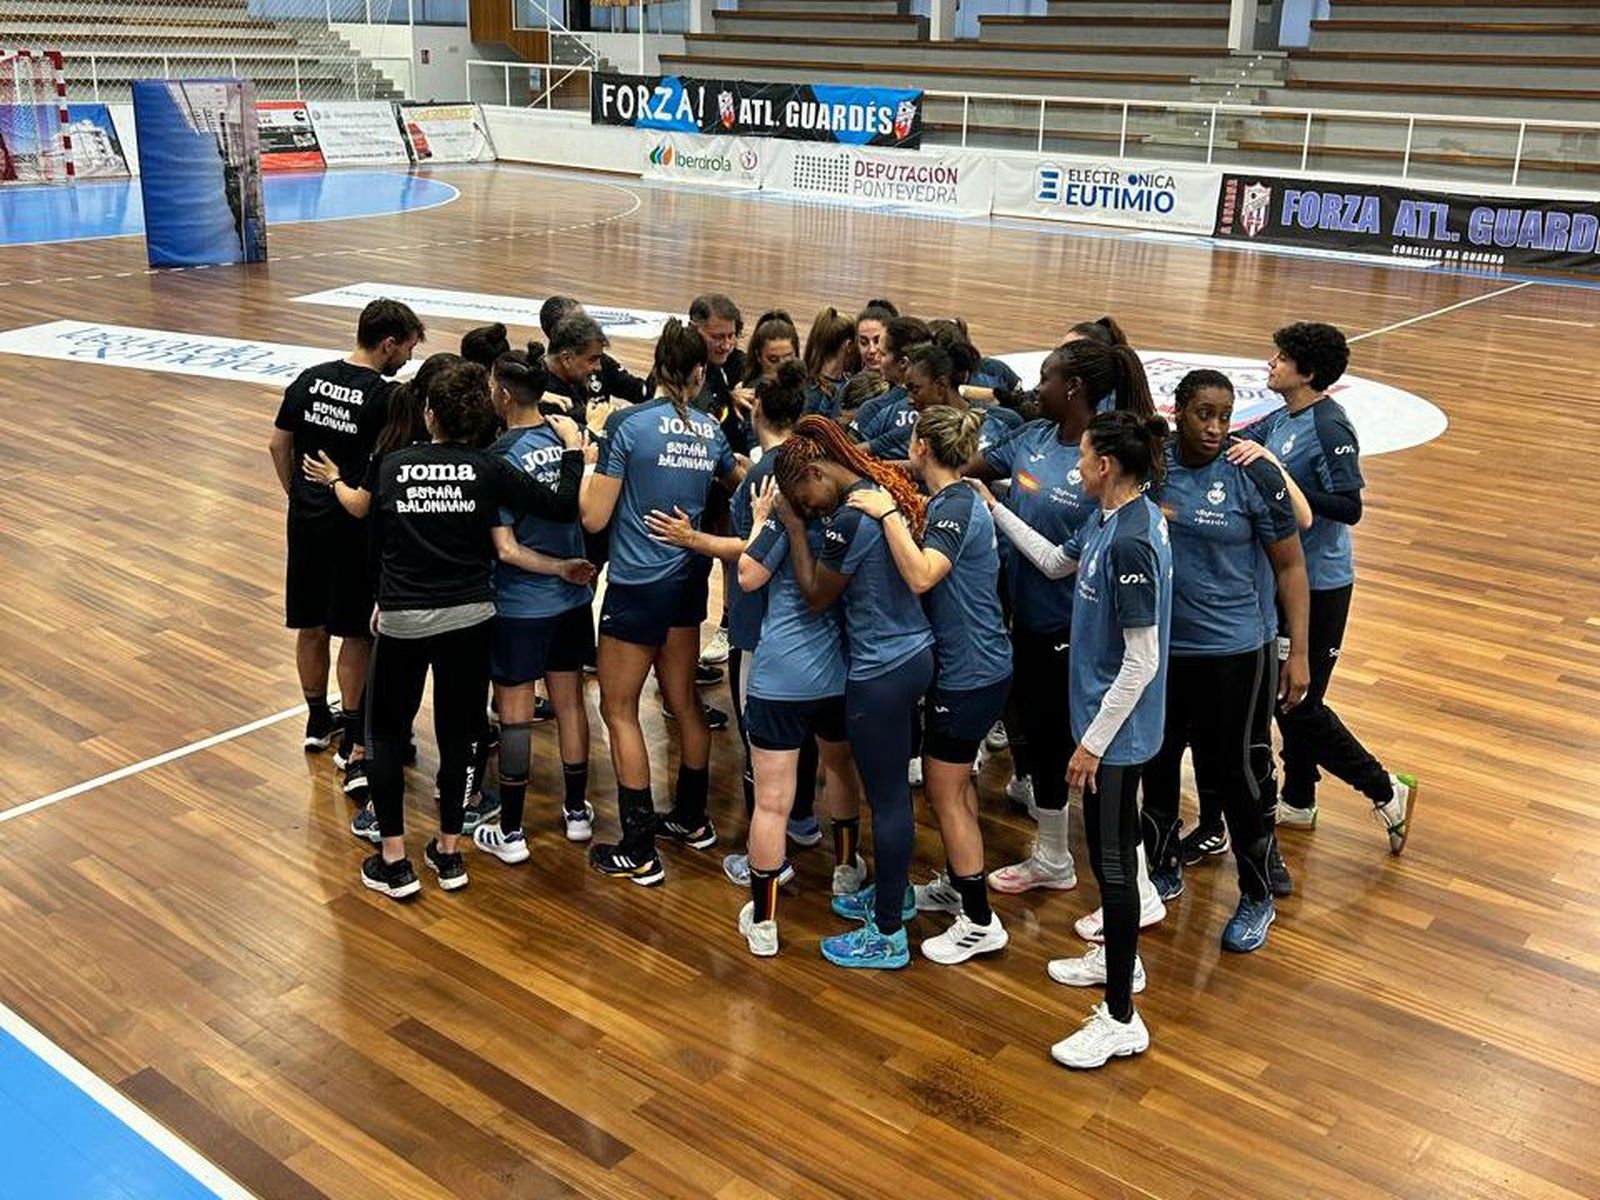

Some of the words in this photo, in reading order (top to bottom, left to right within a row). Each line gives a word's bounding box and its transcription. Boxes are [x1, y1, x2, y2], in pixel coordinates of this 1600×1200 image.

[602, 83, 705, 127] FORZA!
[739, 101, 780, 127] ATL.
[785, 100, 893, 135] GUARDÉS
[675, 151, 731, 172] Iberdrola
[854, 160, 958, 184] DEPUTACIÓN
[853, 180, 958, 204] PONTEVEDRA
[1066, 183, 1175, 214] EUTIMIO
[1281, 189, 1380, 235] FORZA
[1393, 200, 1460, 242] ATL.
[1468, 207, 1600, 254] GUARD
